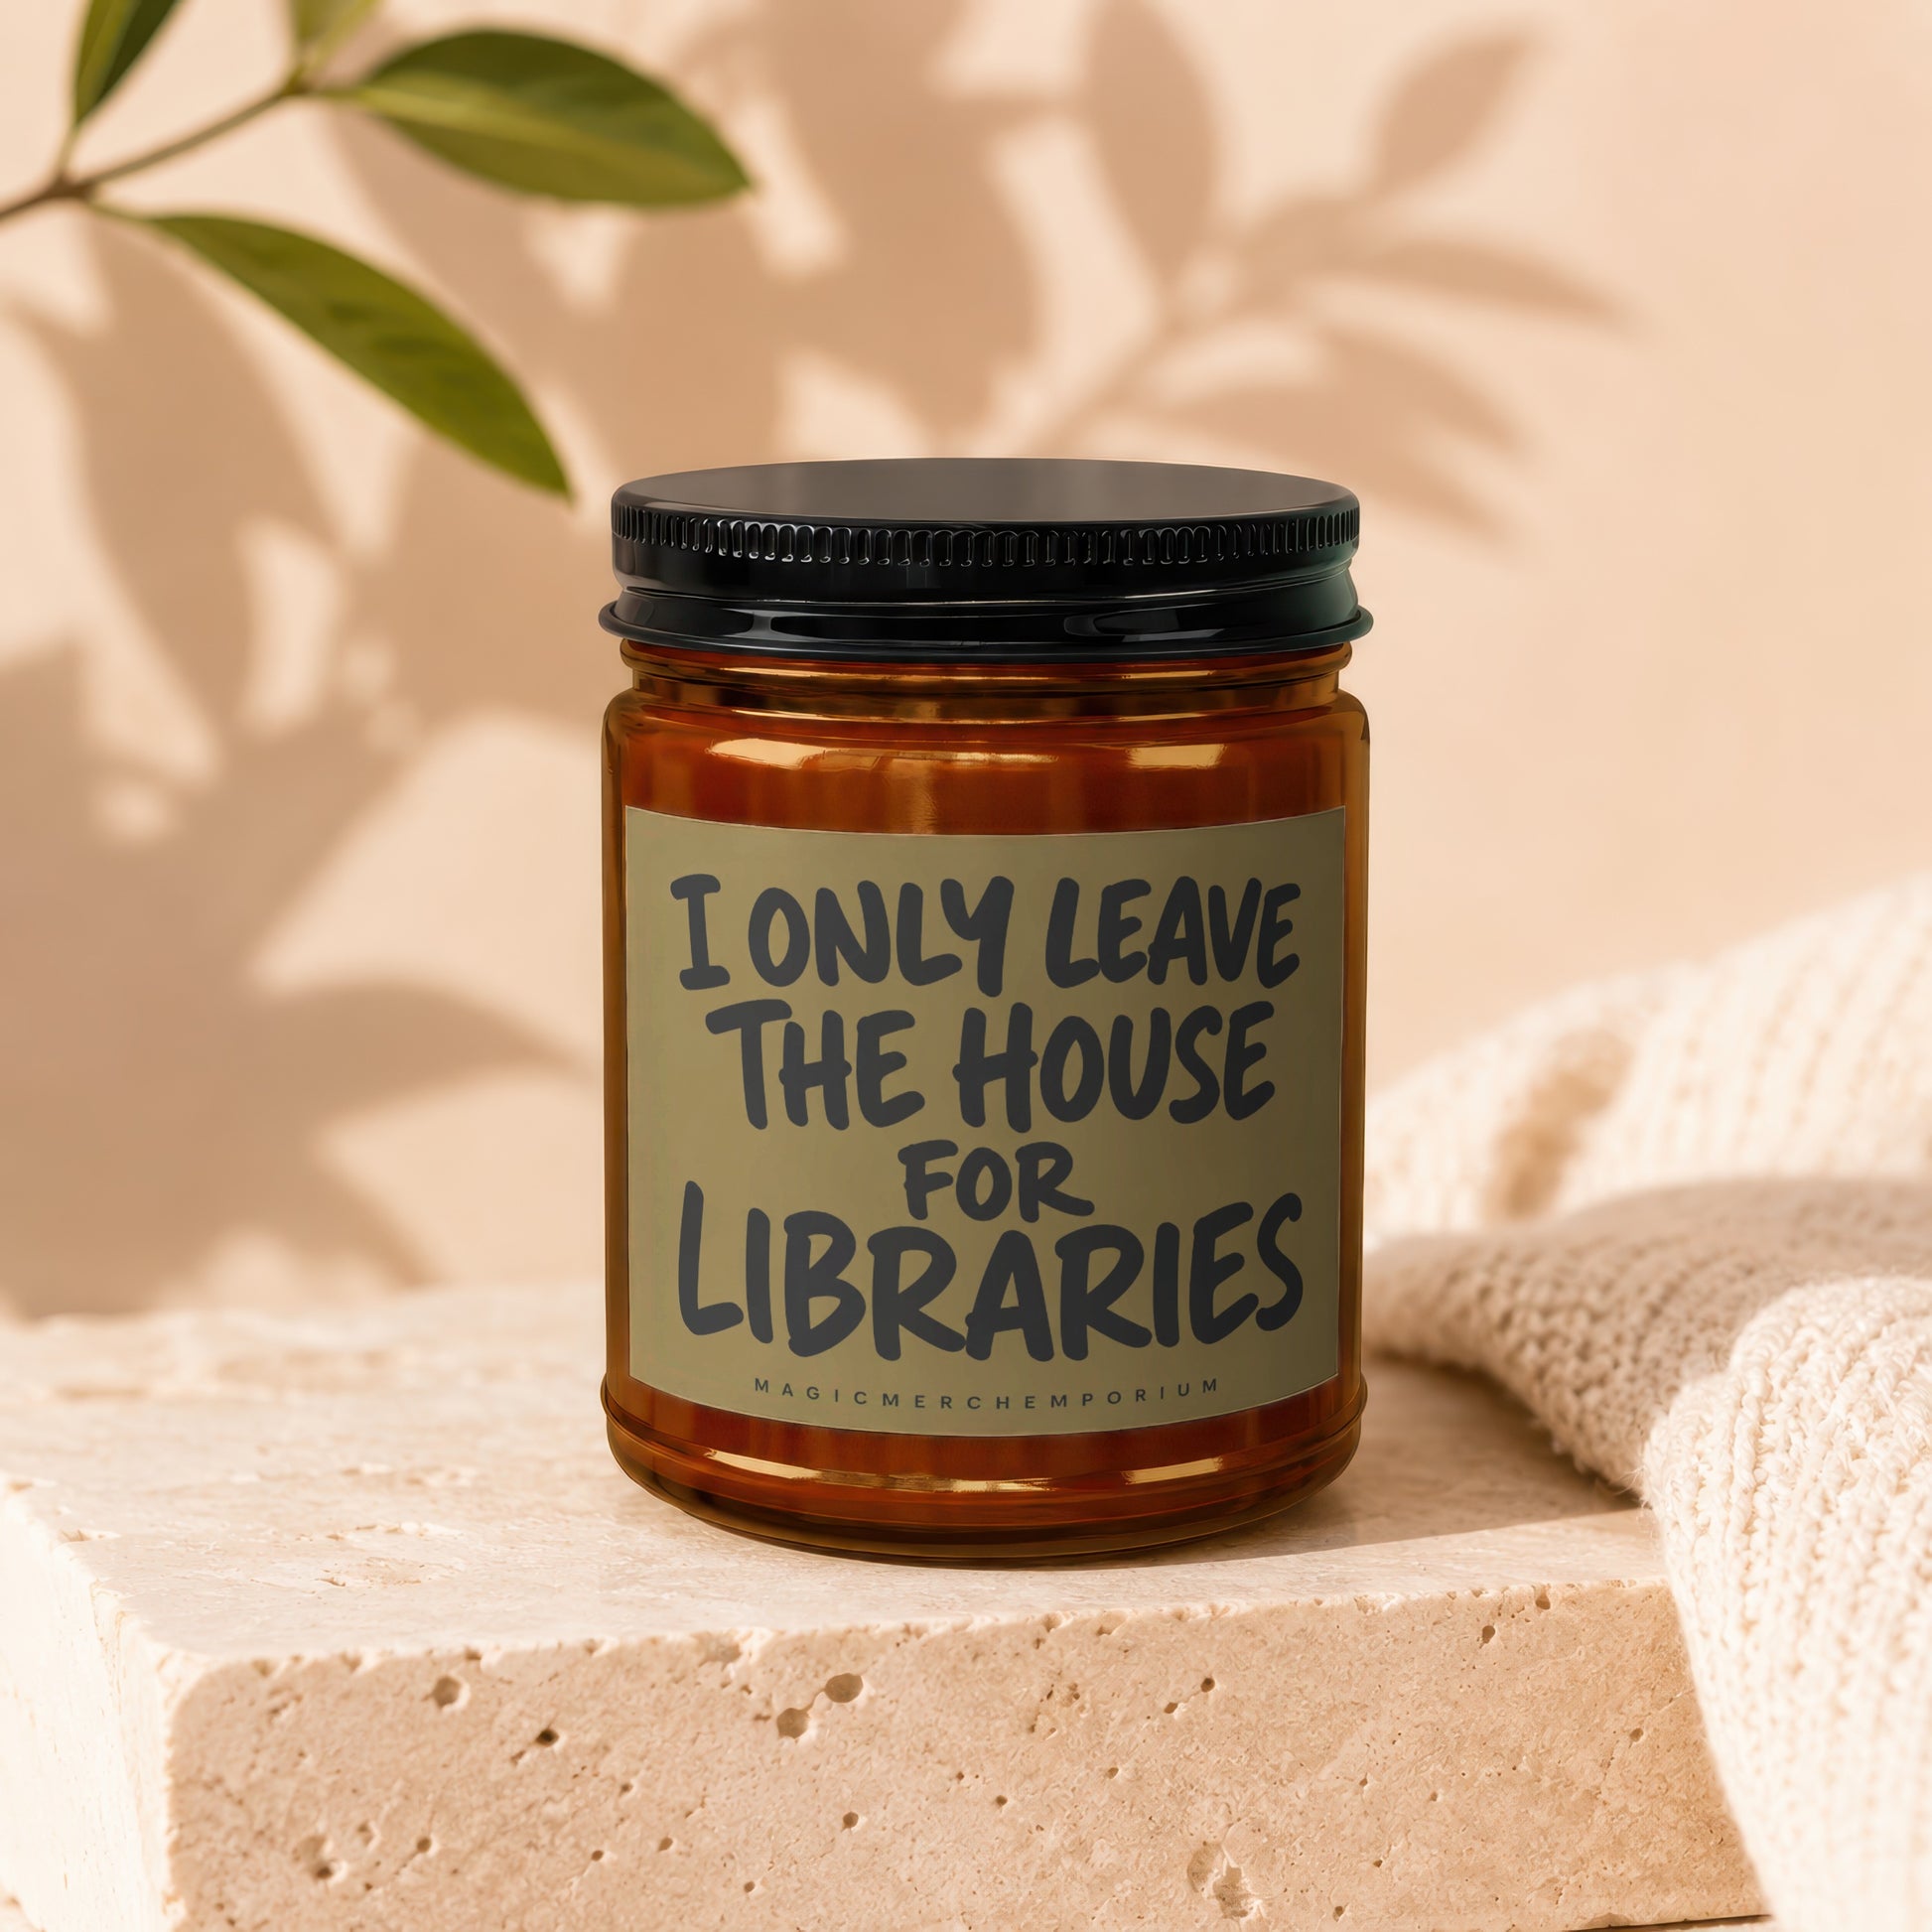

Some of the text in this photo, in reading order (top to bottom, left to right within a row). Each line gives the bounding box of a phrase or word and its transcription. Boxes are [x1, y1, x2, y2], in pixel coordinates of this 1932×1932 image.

[670, 874, 1303, 998] I ONLY LEAVE
[705, 999, 1275, 1134] THE HOUSE
[897, 1139, 1095, 1224] FOR
[678, 1180, 1304, 1363] LIBRARIES
[755, 1377, 1219, 1410] MAGICMERCHEMPORIUM
